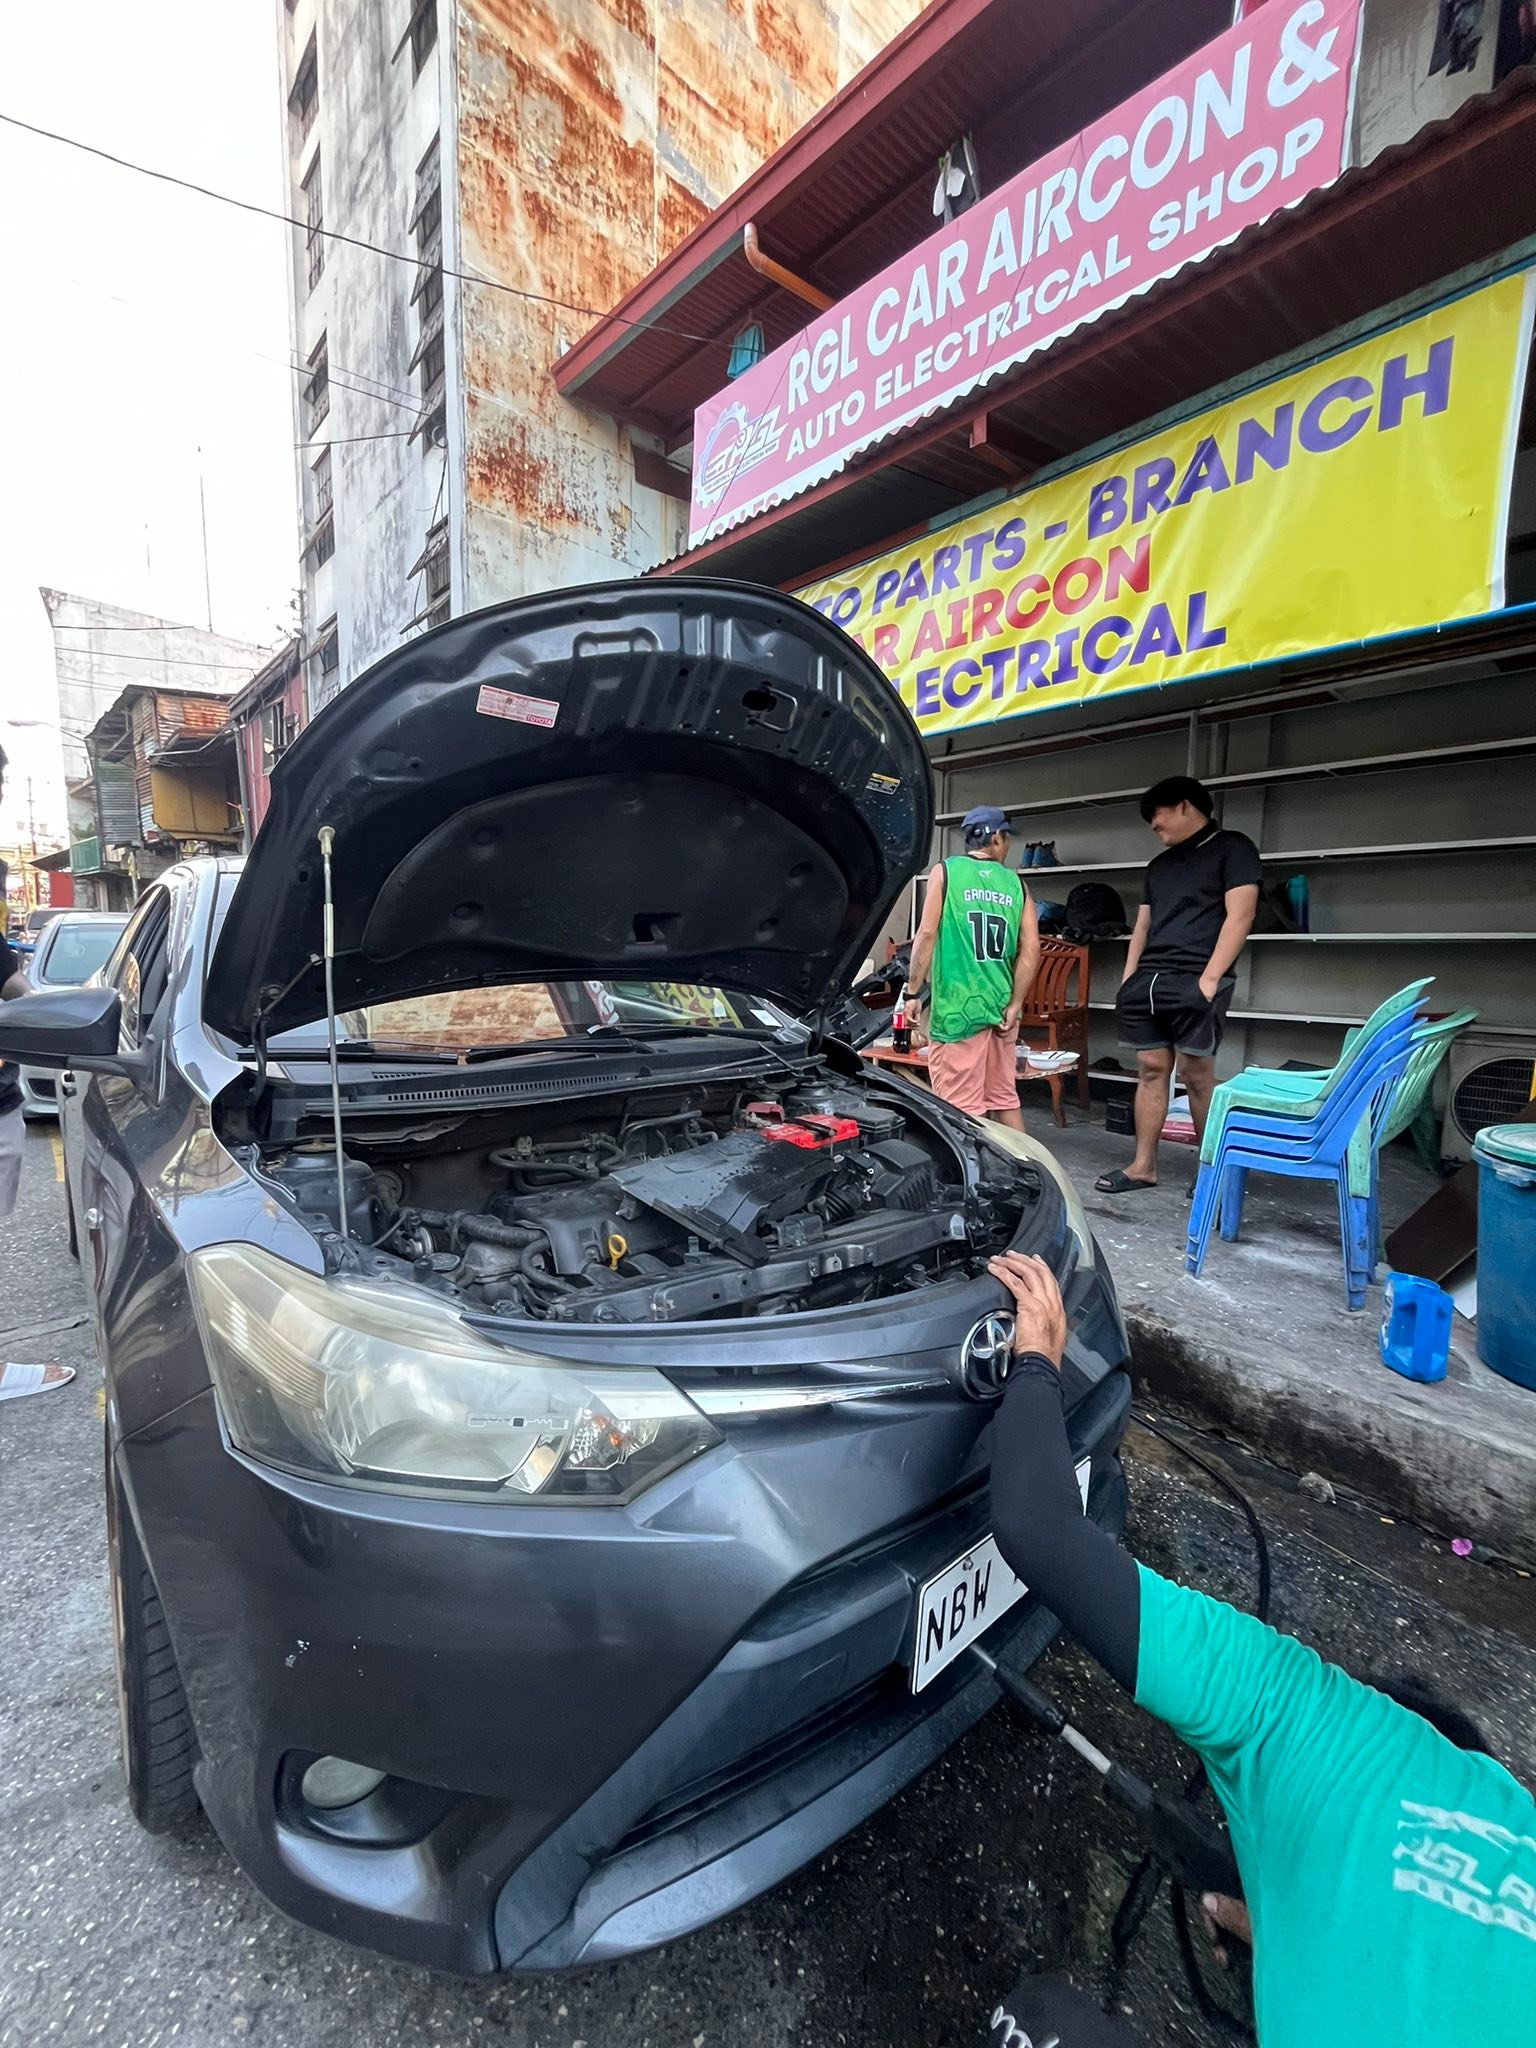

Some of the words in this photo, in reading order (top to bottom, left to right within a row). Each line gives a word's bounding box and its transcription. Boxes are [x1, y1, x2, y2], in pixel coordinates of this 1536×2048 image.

[788, 316, 858, 413] RGL
[867, 240, 968, 356] CAR
[977, 44, 1251, 293] AIRCON
[1267, 0, 1338, 107] &
[786, 390, 865, 462] AUTO
[875, 236, 1130, 409] ELECTRICAL
[1148, 119, 1323, 251] SHOP
[873, 520, 1024, 614] PARTS
[1044, 522, 1066, 540] -
[1089, 340, 1451, 538] BRANCH
[891, 593, 1225, 717] ECTRICAL
[912, 537, 1150, 658] AIRCON
[527, 714, 552, 726] TOYOTA
[964, 888, 1013, 907] GANDEZA
[966, 911, 1009, 962] 10
[924, 1559, 993, 1664] NBW
